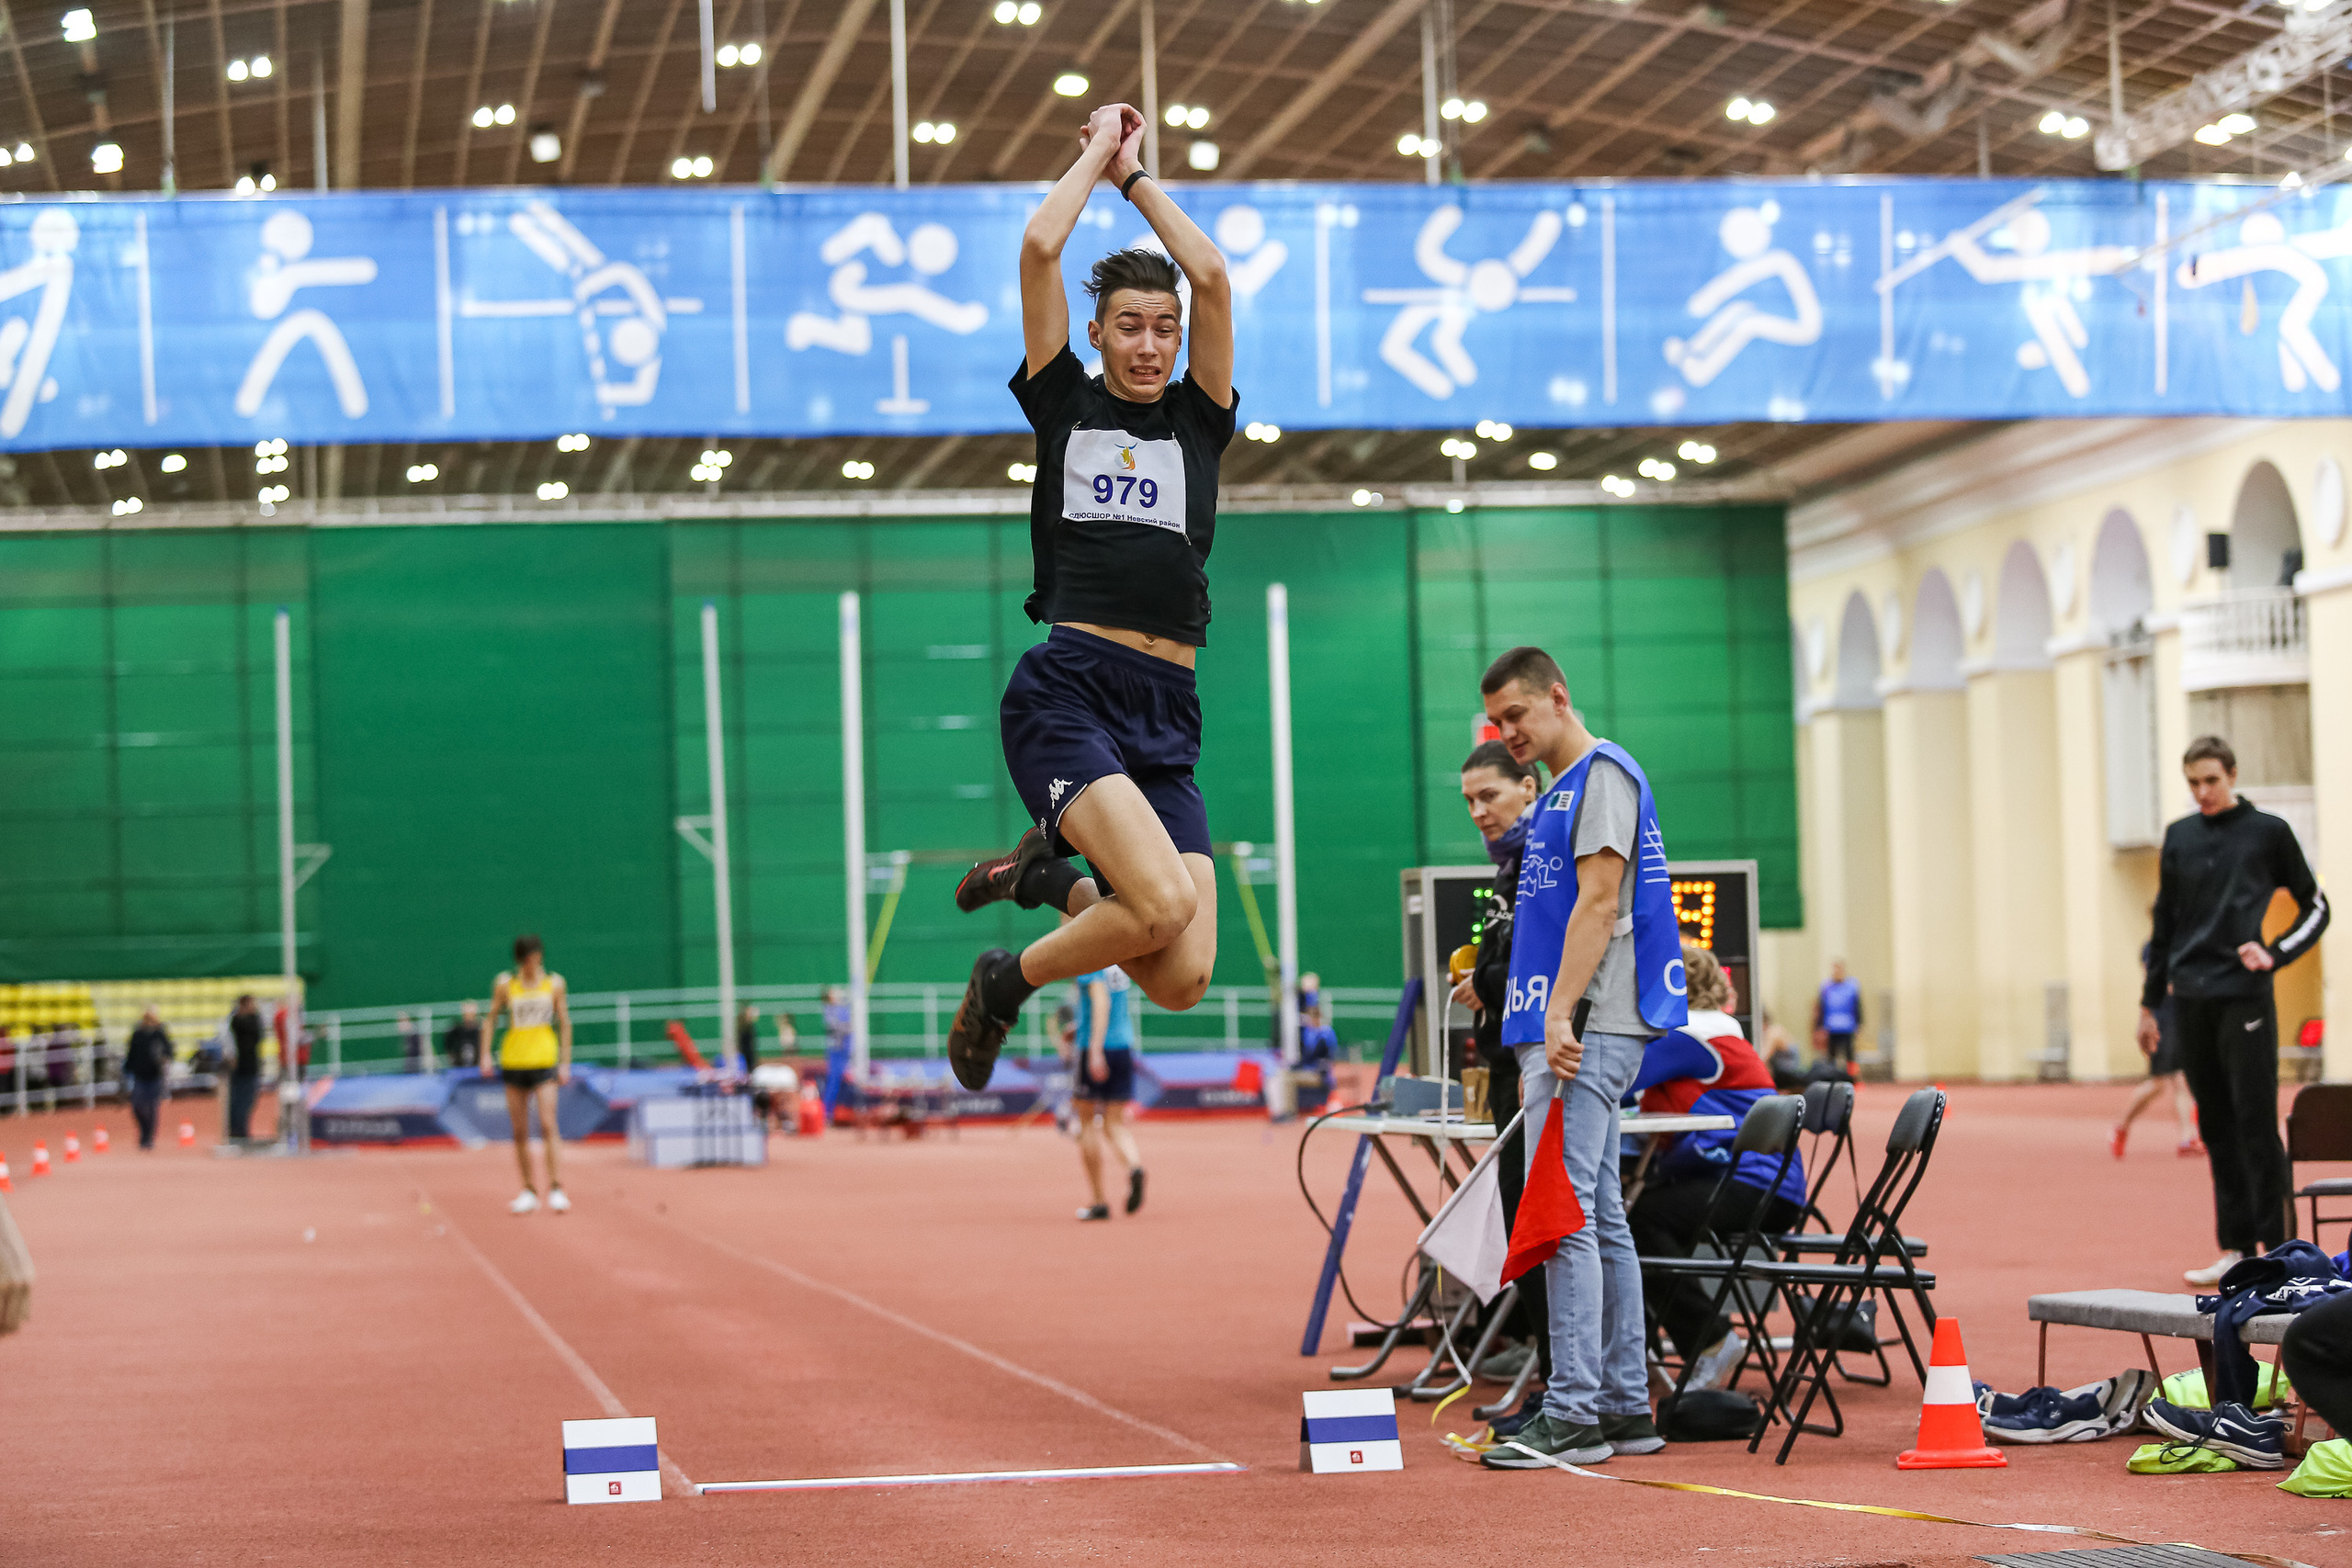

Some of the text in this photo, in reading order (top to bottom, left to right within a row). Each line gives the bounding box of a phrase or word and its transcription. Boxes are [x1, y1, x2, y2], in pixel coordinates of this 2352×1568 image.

[1092, 474, 1159, 509] 979
[1069, 512, 1181, 529] СДЮСШОР №1 Невский район
